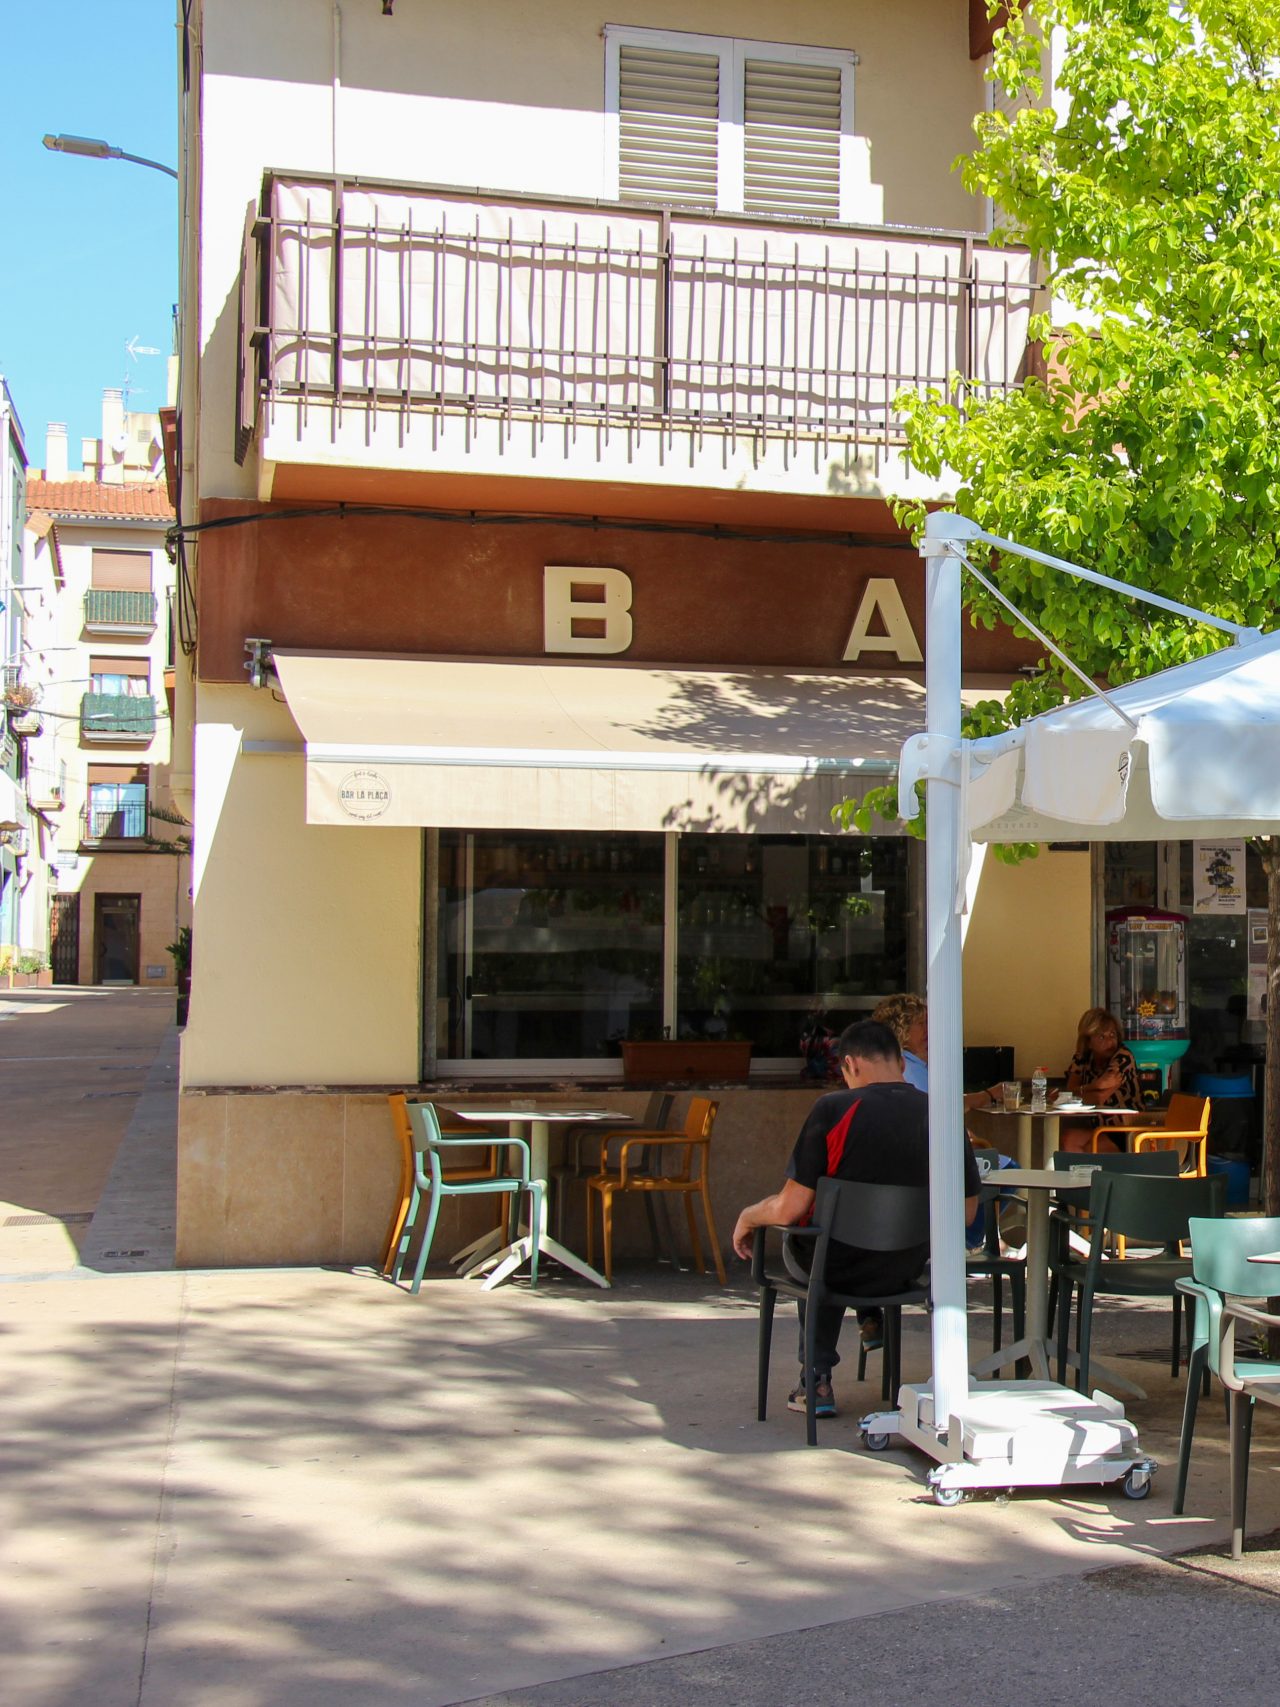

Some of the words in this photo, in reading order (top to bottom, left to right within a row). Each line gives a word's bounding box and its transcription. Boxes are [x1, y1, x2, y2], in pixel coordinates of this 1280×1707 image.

[341, 790, 354, 799] BAR
[356, 790, 365, 799] LA
[368, 791, 388, 800] PLAÇA
